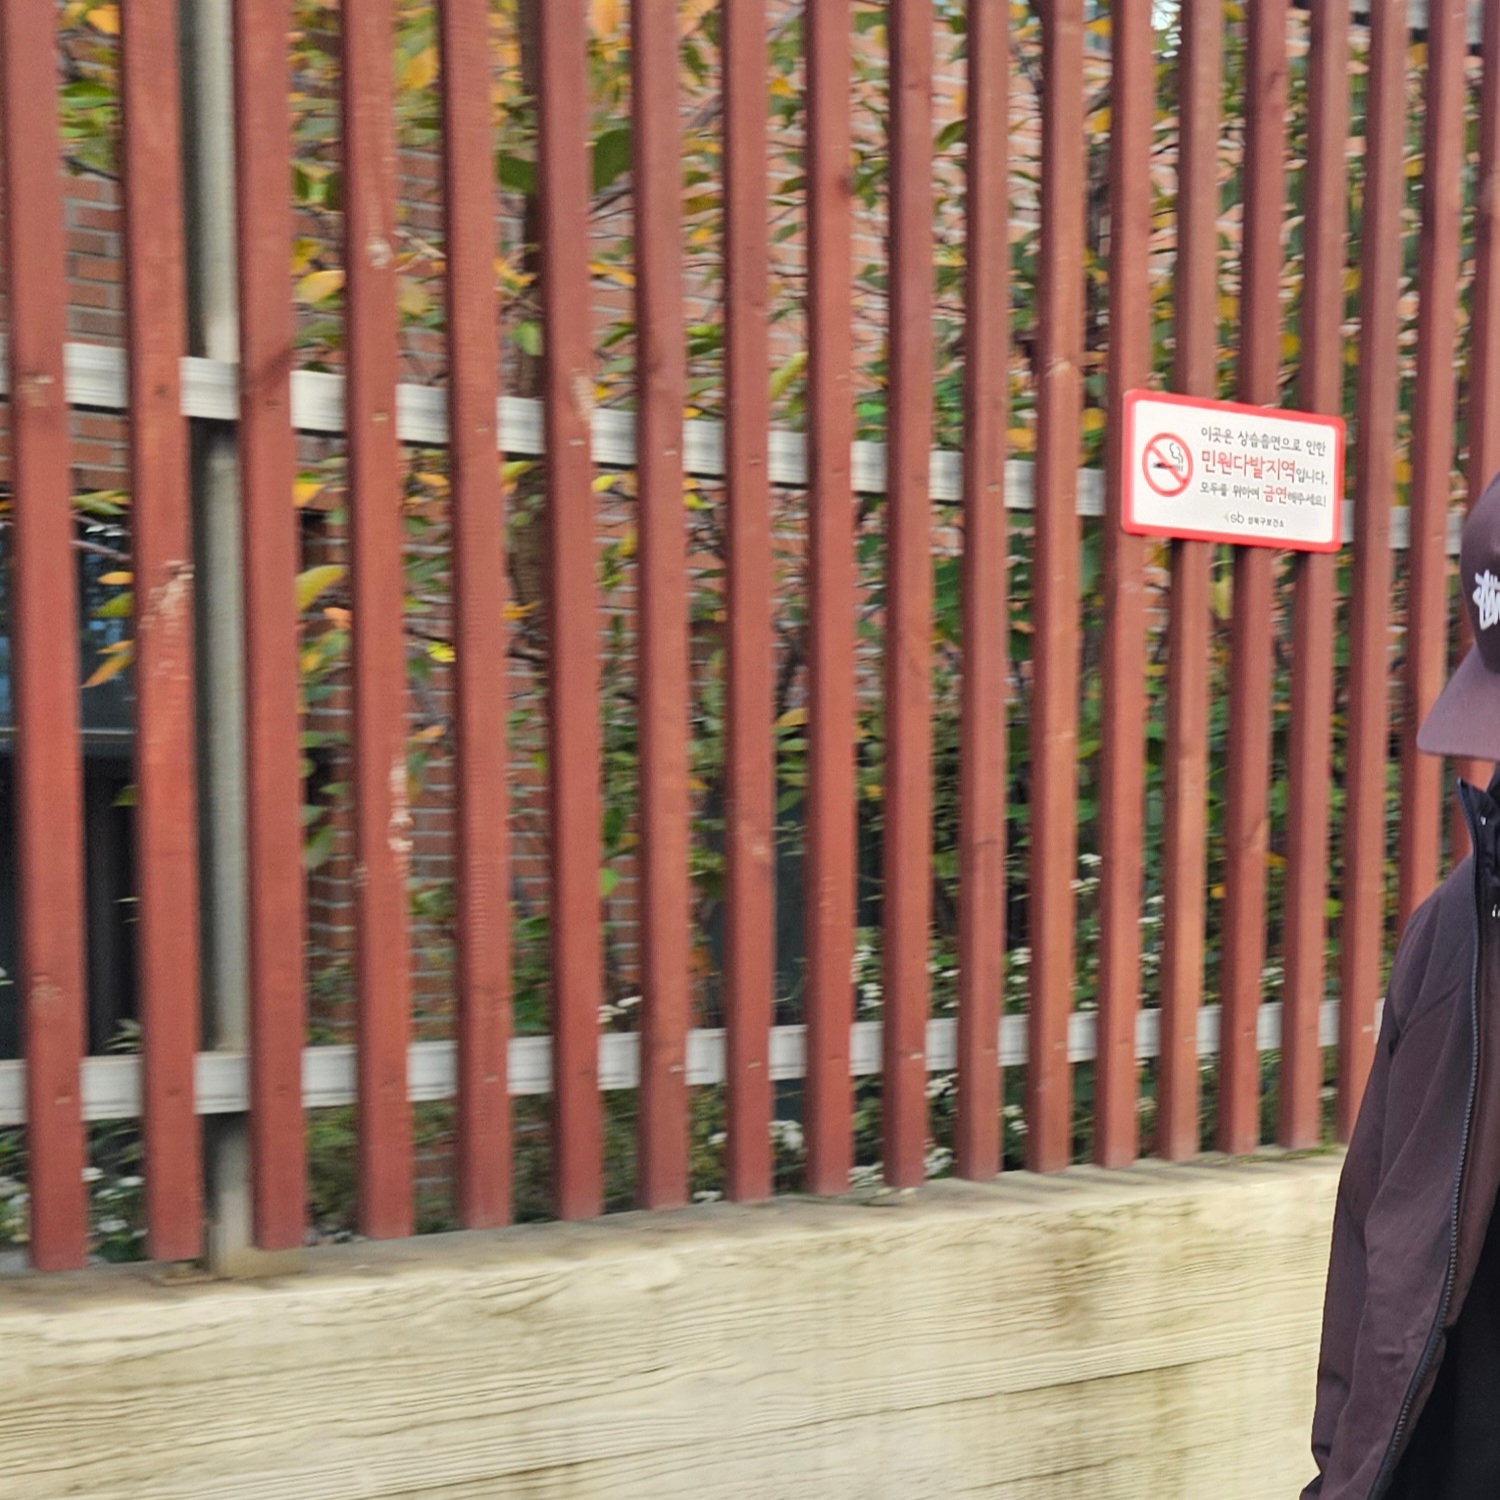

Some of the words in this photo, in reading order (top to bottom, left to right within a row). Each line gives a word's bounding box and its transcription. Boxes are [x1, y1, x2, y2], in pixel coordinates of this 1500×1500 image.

[1201, 426, 1234, 444] 이곳은
[1238, 430, 1302, 452] 상습흡연으로
[1306, 440, 1326, 457] 인한
[1201, 450, 1328, 485] 민원다발지역입니다.
[1200, 481, 1228, 497] 모두를
